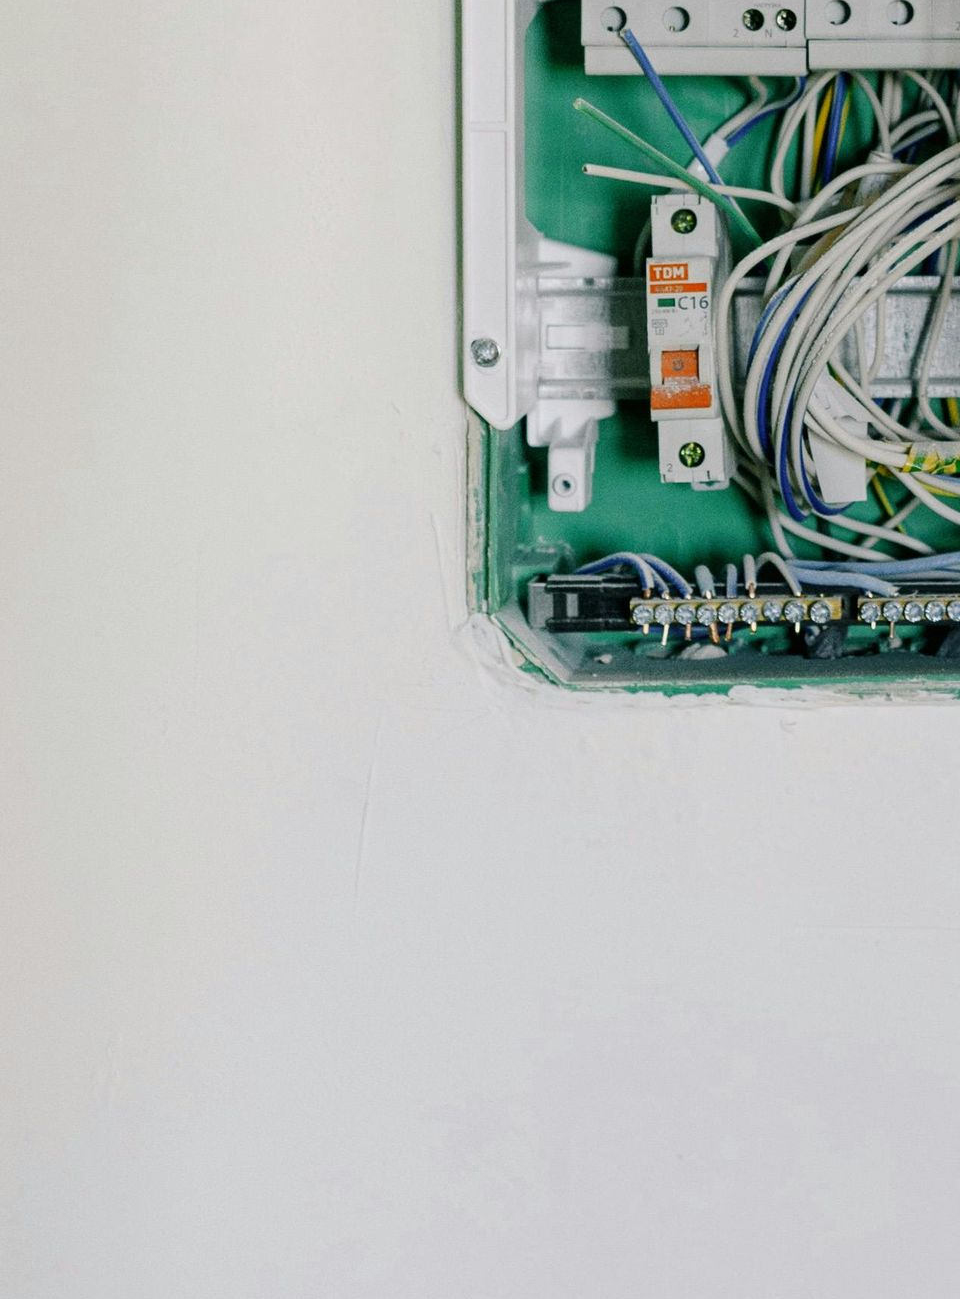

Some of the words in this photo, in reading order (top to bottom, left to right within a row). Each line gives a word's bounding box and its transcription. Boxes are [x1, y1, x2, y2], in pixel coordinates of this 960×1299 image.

[732, 28, 739, 38] 2
[764, 28, 772, 38] N
[653, 267, 685, 279] TDM
[678, 295, 709, 310] C16
[666, 462, 673, 473] 2
